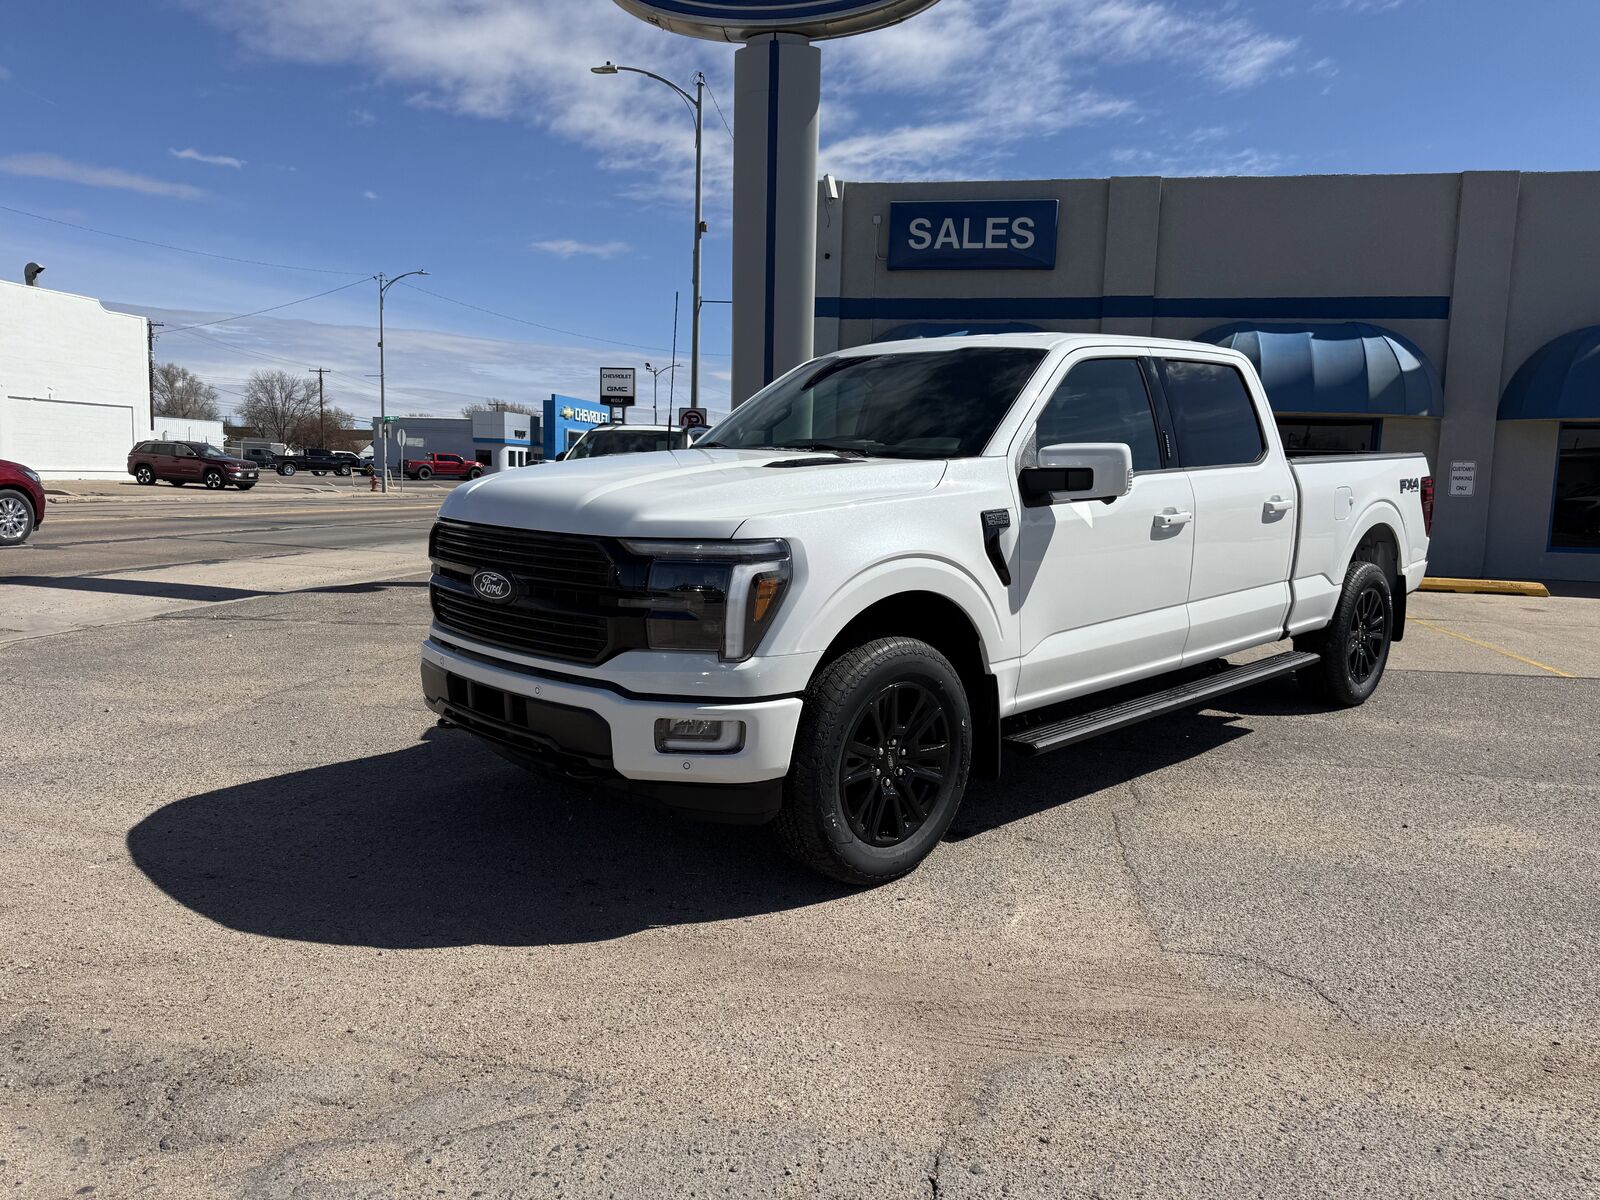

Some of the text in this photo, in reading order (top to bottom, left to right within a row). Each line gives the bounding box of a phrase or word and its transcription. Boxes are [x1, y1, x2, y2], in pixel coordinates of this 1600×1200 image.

[908, 217, 1035, 249] SALES
[574, 407, 609, 424] CHEVROLET
[1399, 477, 1419, 494] FX4
[480, 574, 504, 595] Ford
